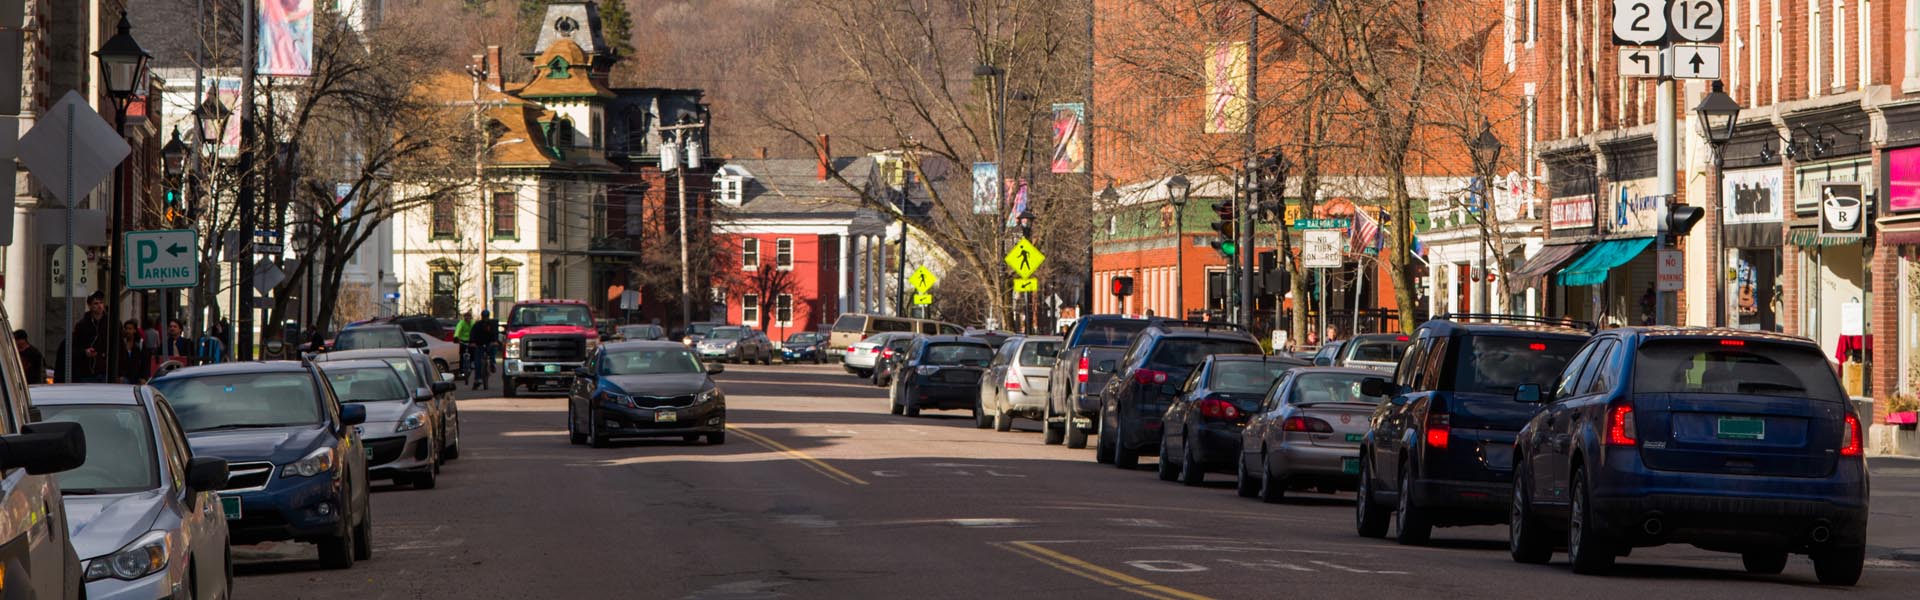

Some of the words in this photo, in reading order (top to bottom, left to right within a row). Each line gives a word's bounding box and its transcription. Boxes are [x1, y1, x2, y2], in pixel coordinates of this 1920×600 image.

[1631, 3, 1650, 31] 2
[1680, 1, 1713, 30] 12
[1313, 244, 1332, 252] TURN
[1325, 253, 1338, 261] RED
[137, 239, 190, 280] PARKING
[1665, 258, 1676, 267] NO
